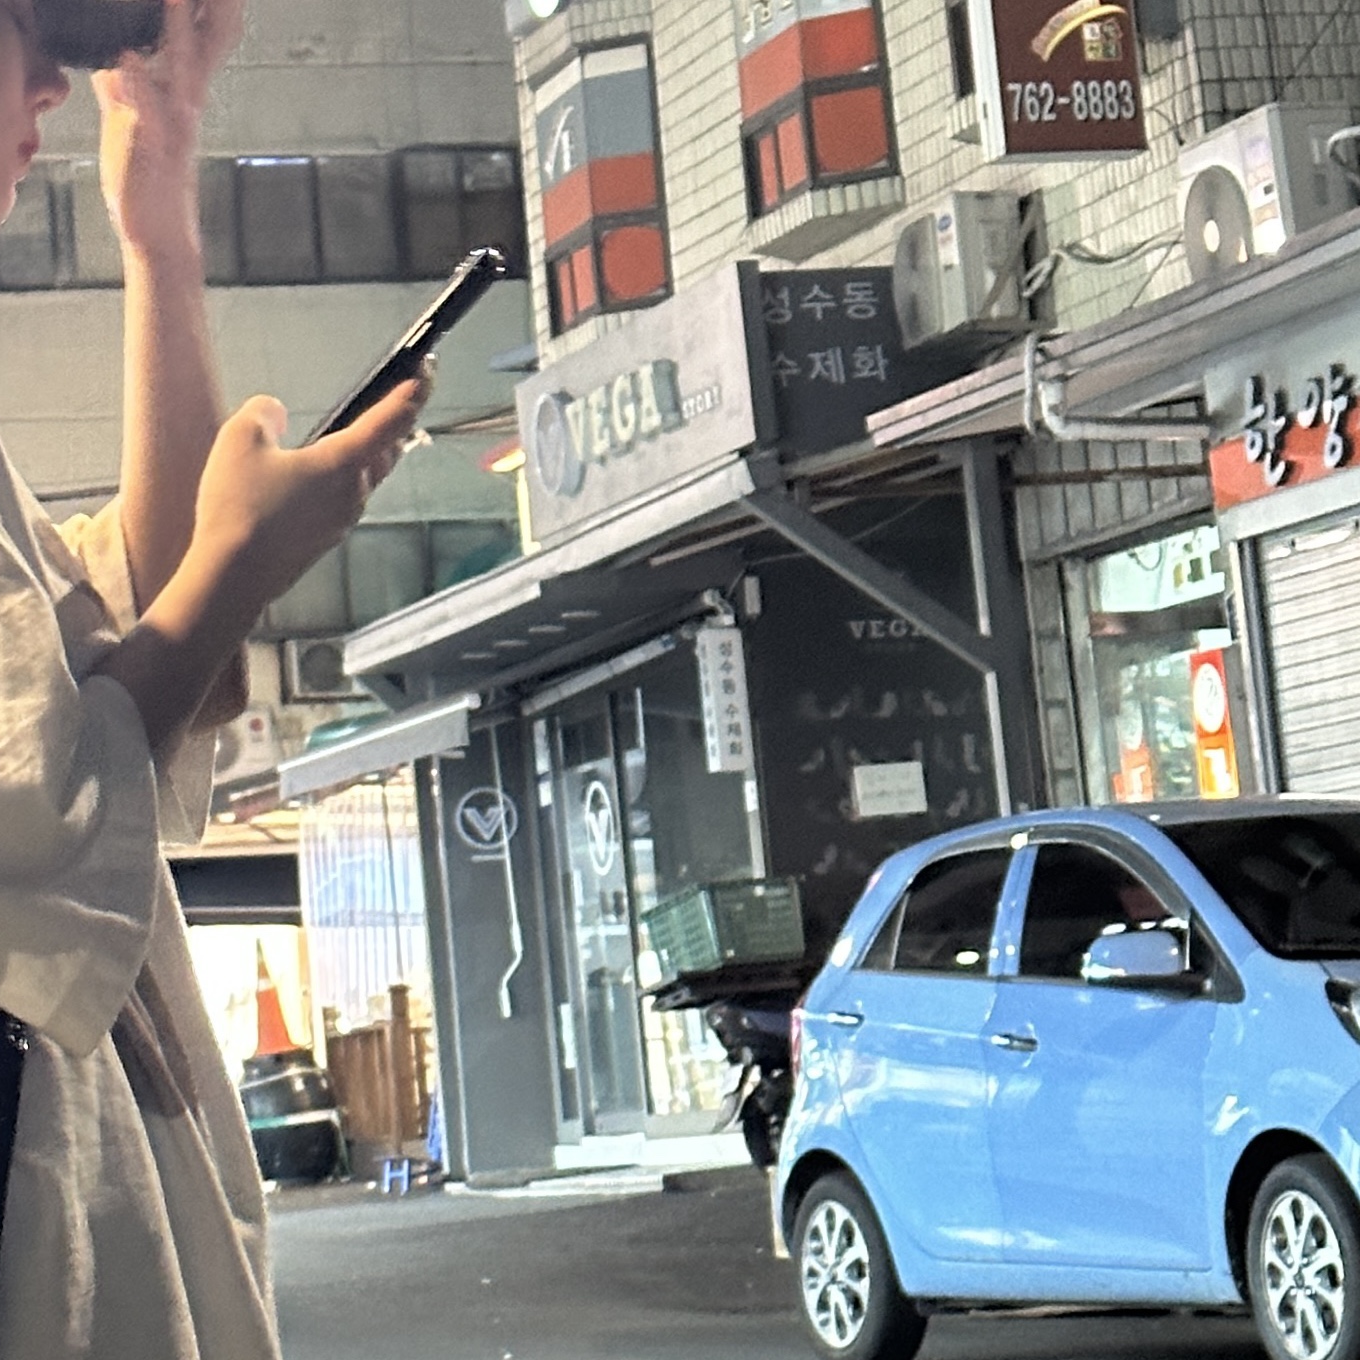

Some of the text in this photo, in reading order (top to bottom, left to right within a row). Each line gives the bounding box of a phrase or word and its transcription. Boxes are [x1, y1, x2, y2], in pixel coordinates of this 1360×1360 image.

[1005, 79, 1136, 123] 762-8883
[762, 281, 880, 324] 성수동
[771, 343, 890, 387] 수제화
[565, 362, 666, 462] VEGA
